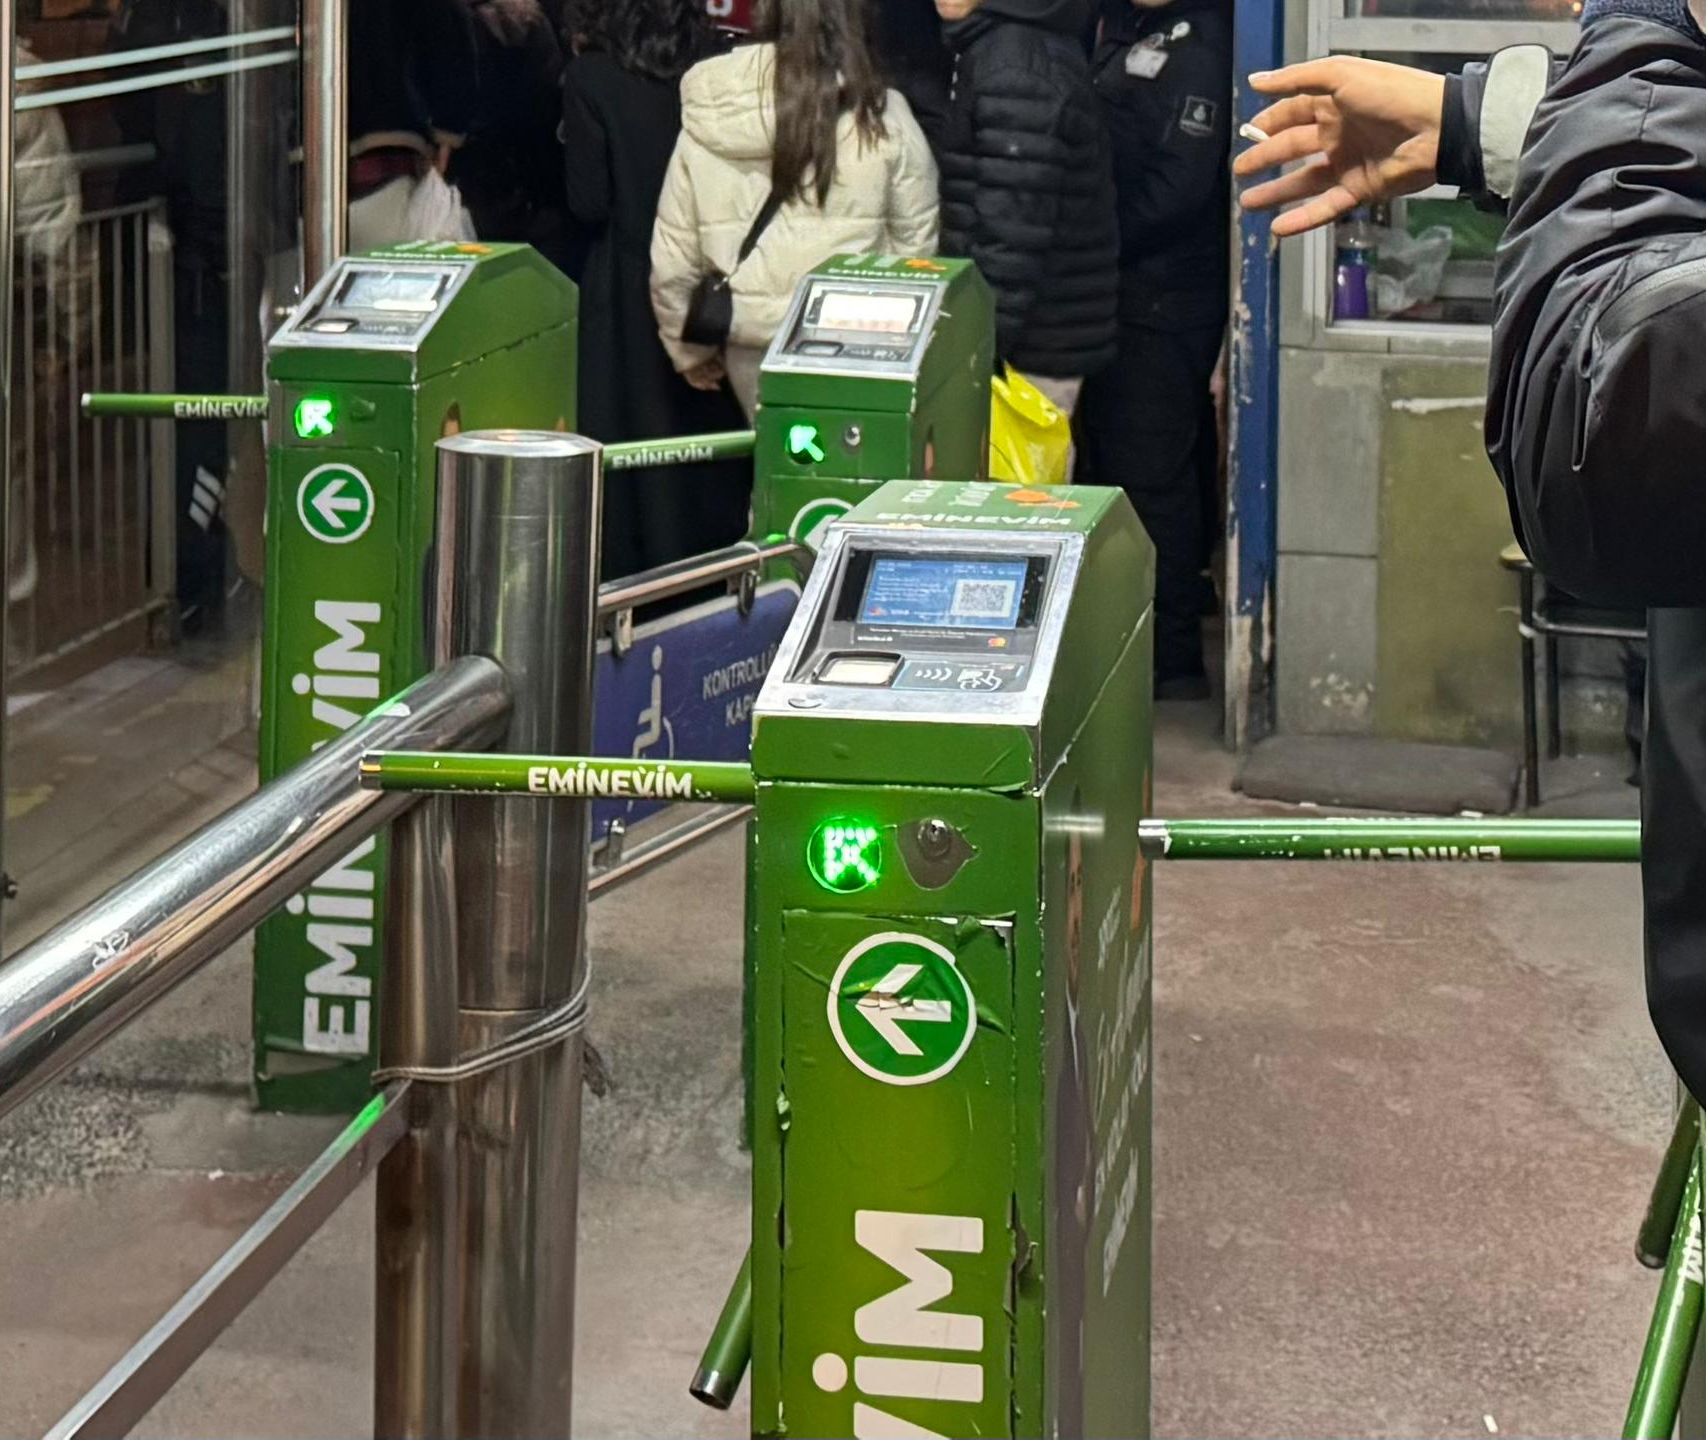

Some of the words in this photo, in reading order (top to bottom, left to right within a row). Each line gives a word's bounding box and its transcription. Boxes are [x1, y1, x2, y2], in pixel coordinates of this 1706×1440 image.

[173, 397, 269, 420] EMİNEVİM
[612, 442, 714, 470] EMİNEVİM
[876, 512, 1072, 526] EMİNEVİM
[527, 762, 693, 799] EMİNEVİM
